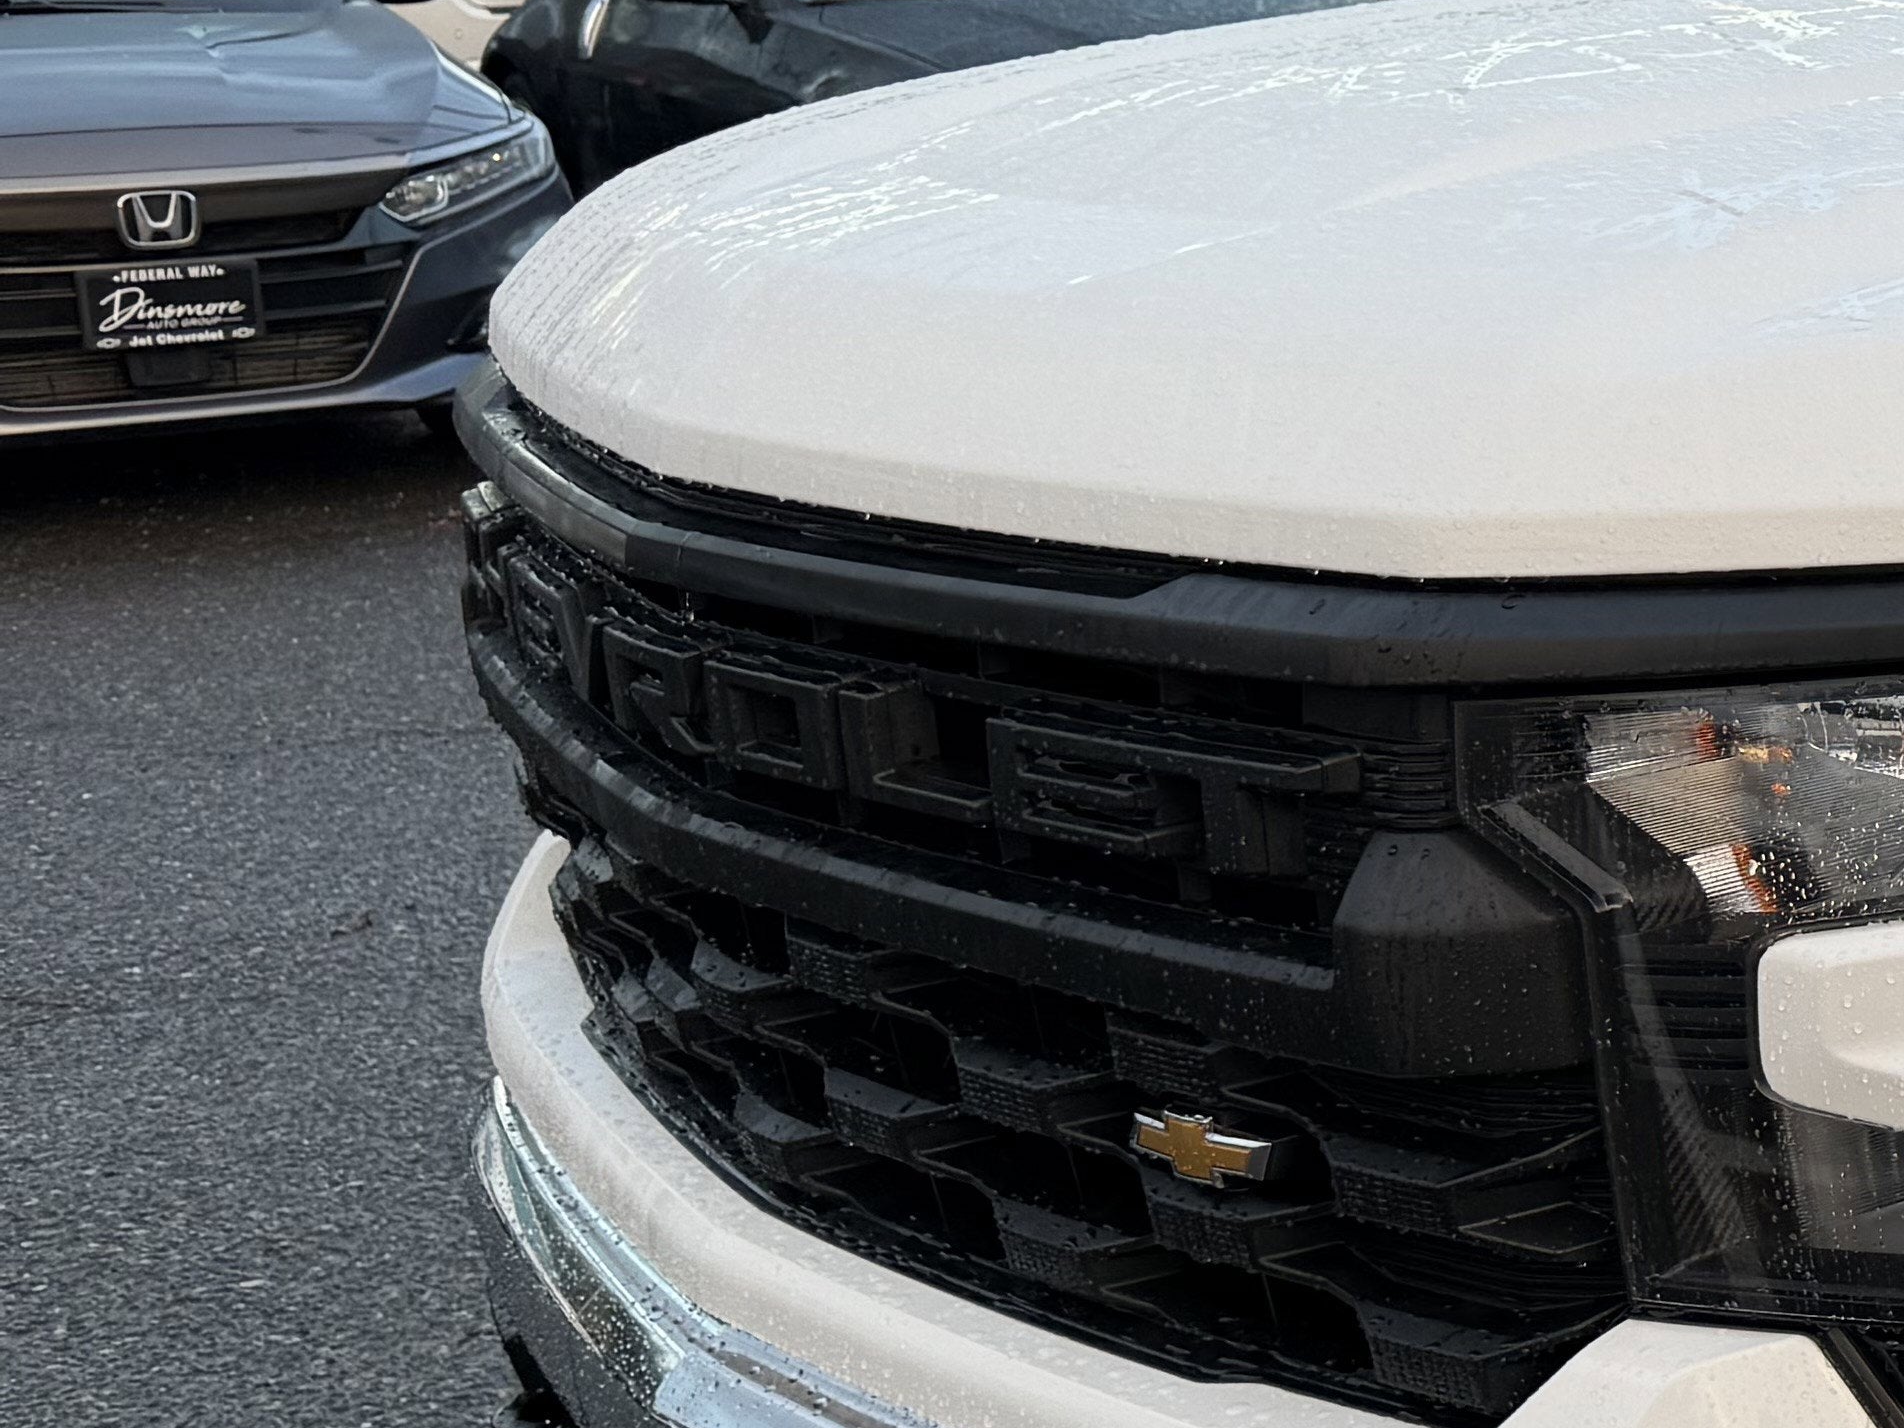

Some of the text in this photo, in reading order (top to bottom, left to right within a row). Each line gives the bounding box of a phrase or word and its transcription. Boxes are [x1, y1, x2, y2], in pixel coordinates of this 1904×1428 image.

[121, 264, 218, 283] FEDERAL WAY
[99, 286, 246, 332] Dinsmore
[146, 316, 223, 330] AUTO GROUP
[129, 329, 226, 348] Jet Chevrolet
